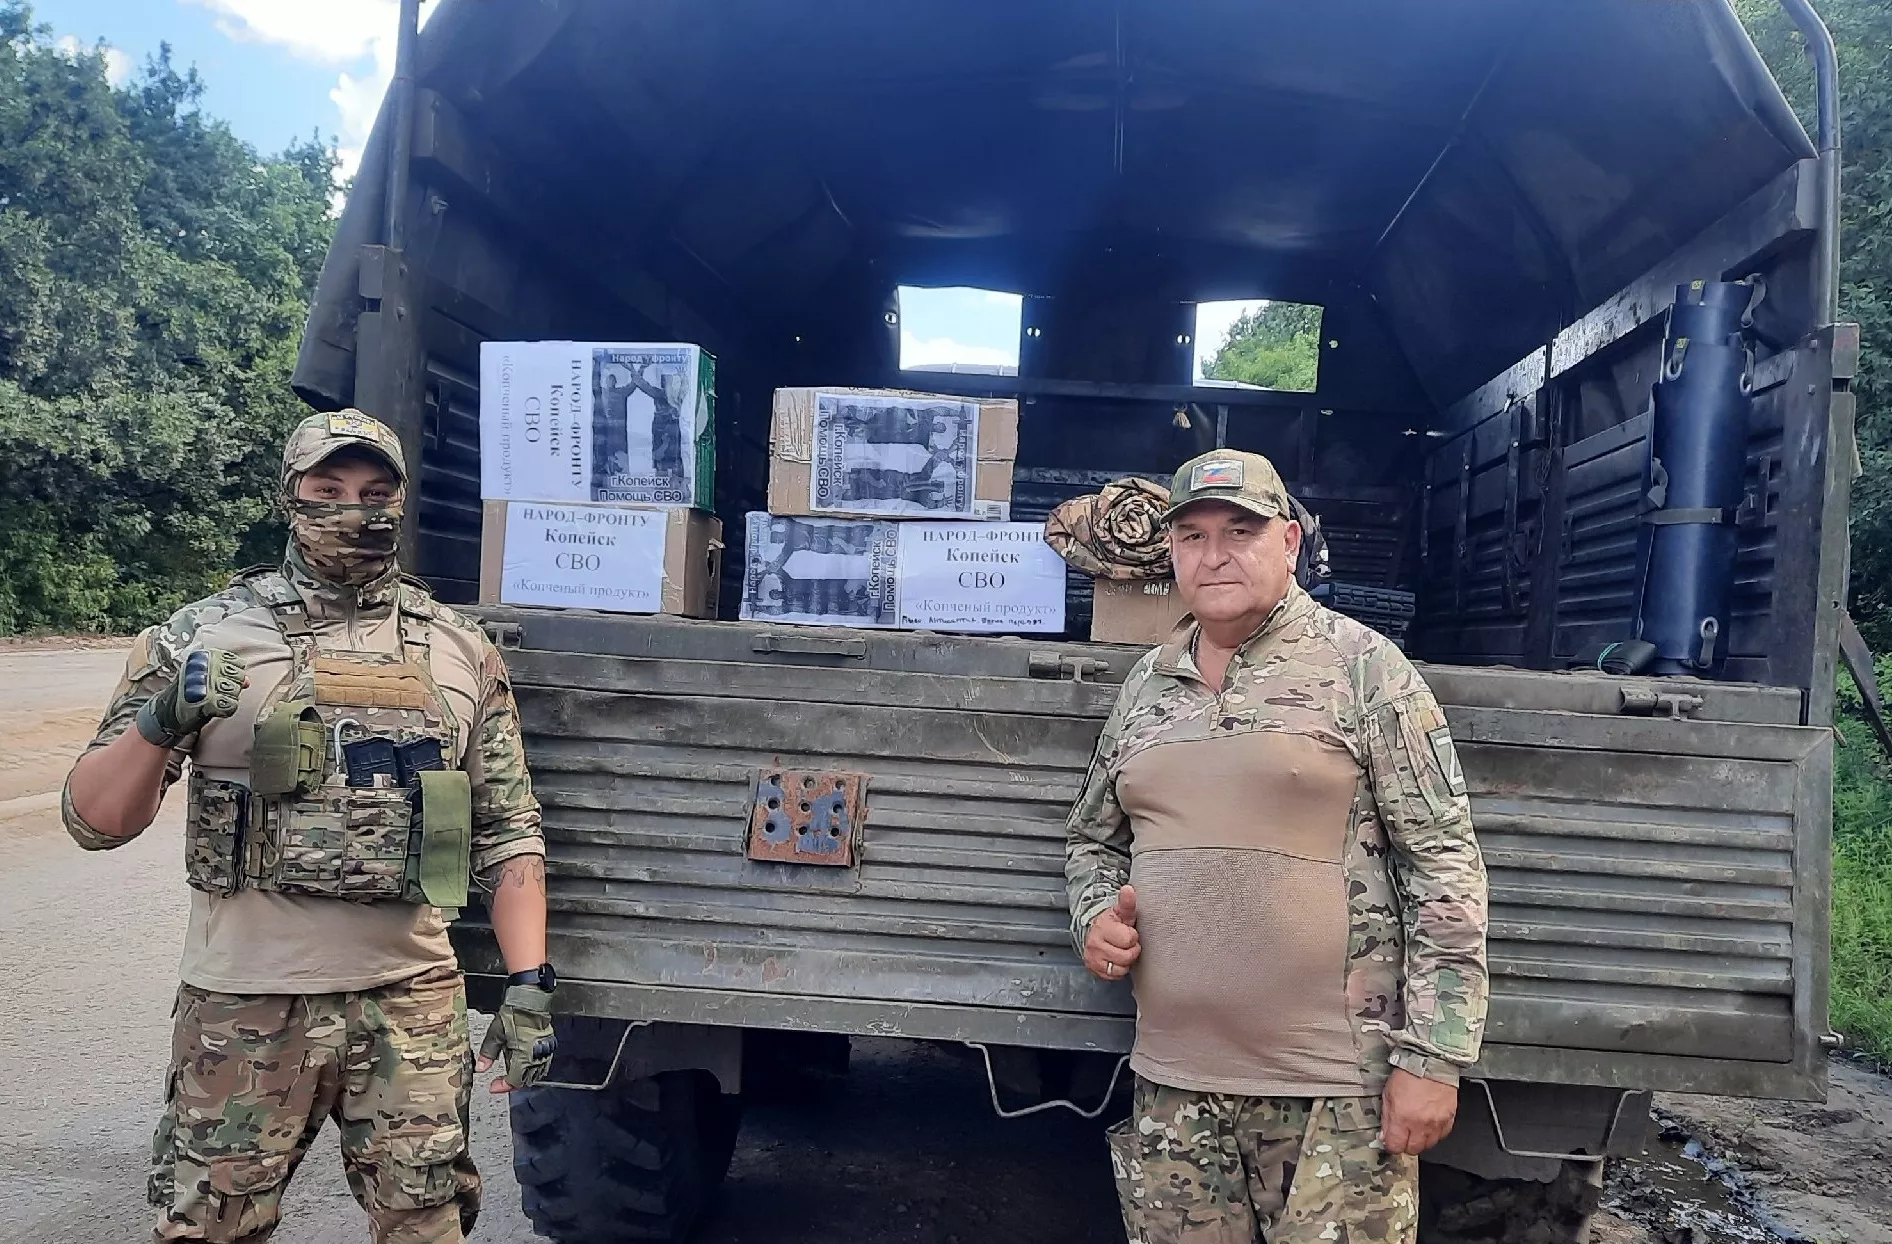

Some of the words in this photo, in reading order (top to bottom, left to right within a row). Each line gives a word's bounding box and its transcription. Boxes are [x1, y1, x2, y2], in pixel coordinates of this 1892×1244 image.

[524, 396, 541, 444] СВО
[550, 384, 564, 457] Копейск
[818, 410, 831, 465] Помощь
[832, 423, 847, 486] г.Копейск
[611, 475, 671, 487] г.Копейск
[817, 467, 830, 498] СВО
[600, 490, 651, 502] Помощь
[653, 490, 682, 502] СВО
[544, 528, 616, 546] Копейск
[885, 529, 897, 557] СВО
[555, 552, 600, 571] СВО
[868, 540, 881, 597] г.Копейск
[946, 548, 1021, 564] Копейск
[883, 559, 897, 611] Помощь
[958, 571, 1005, 589] СВО
